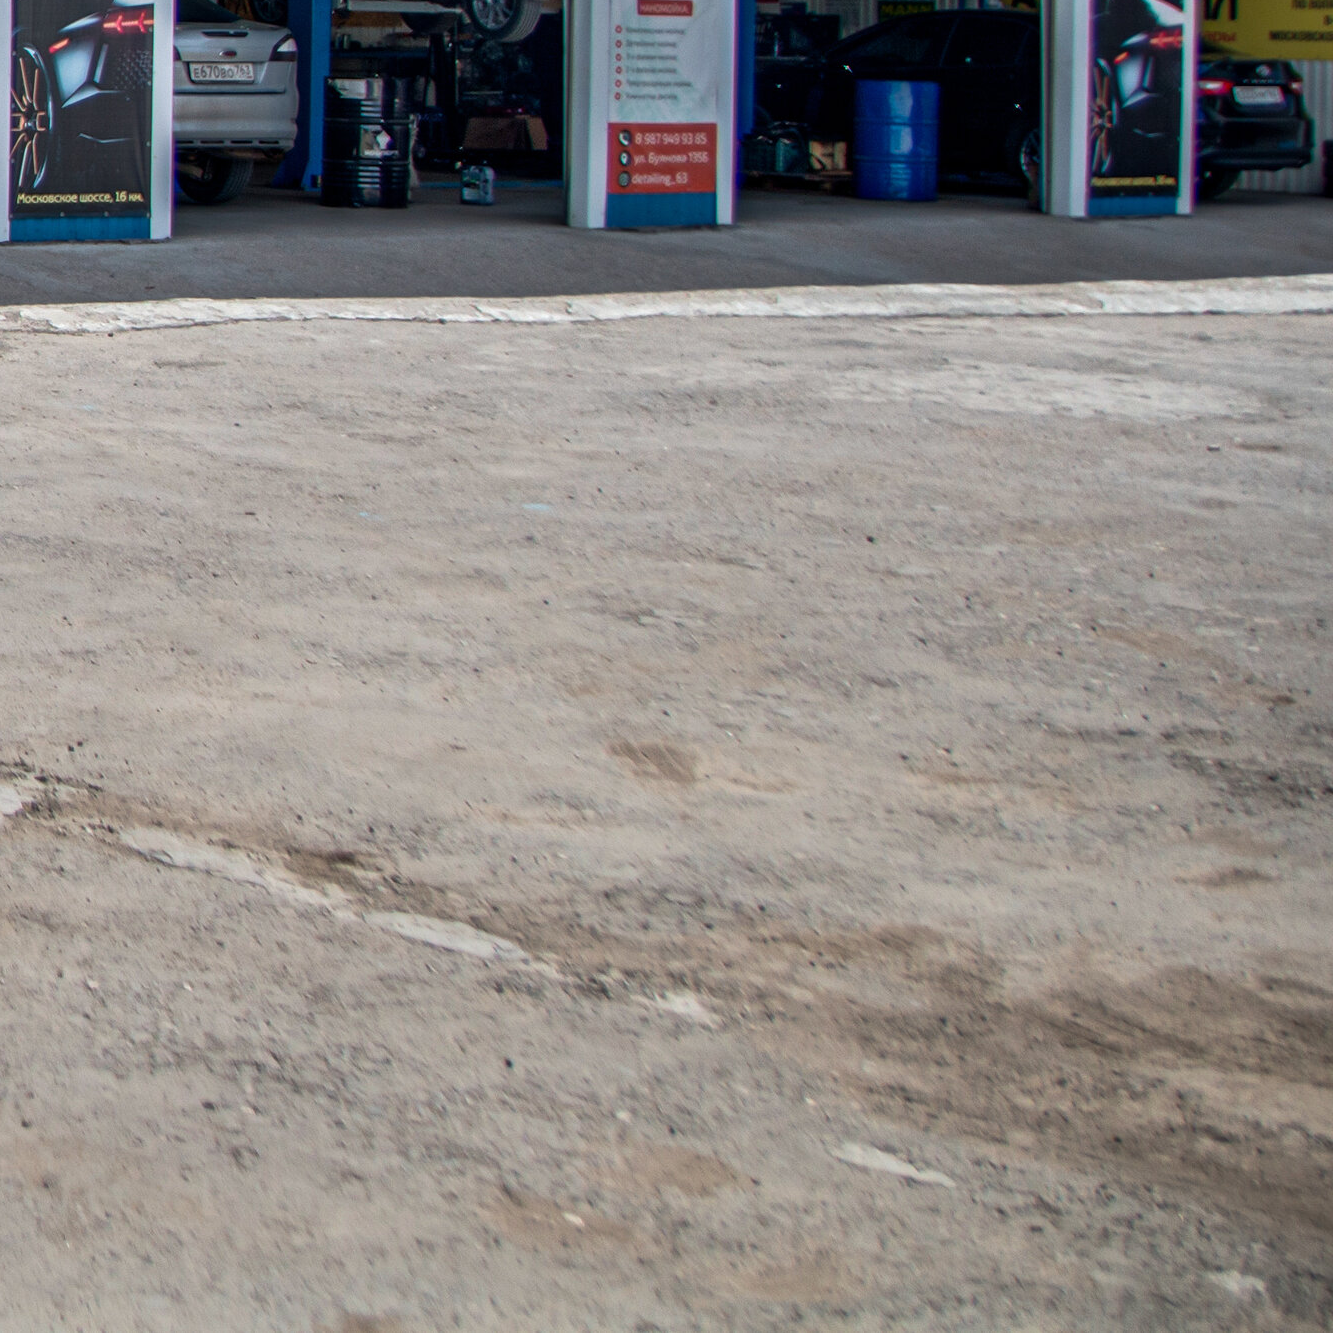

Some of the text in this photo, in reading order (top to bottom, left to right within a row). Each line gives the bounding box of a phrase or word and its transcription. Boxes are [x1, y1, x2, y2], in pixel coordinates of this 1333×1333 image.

[17, 192, 78, 204] Московское
[79, 193, 113, 204] шоссе,
[115, 191, 126, 203] 16
